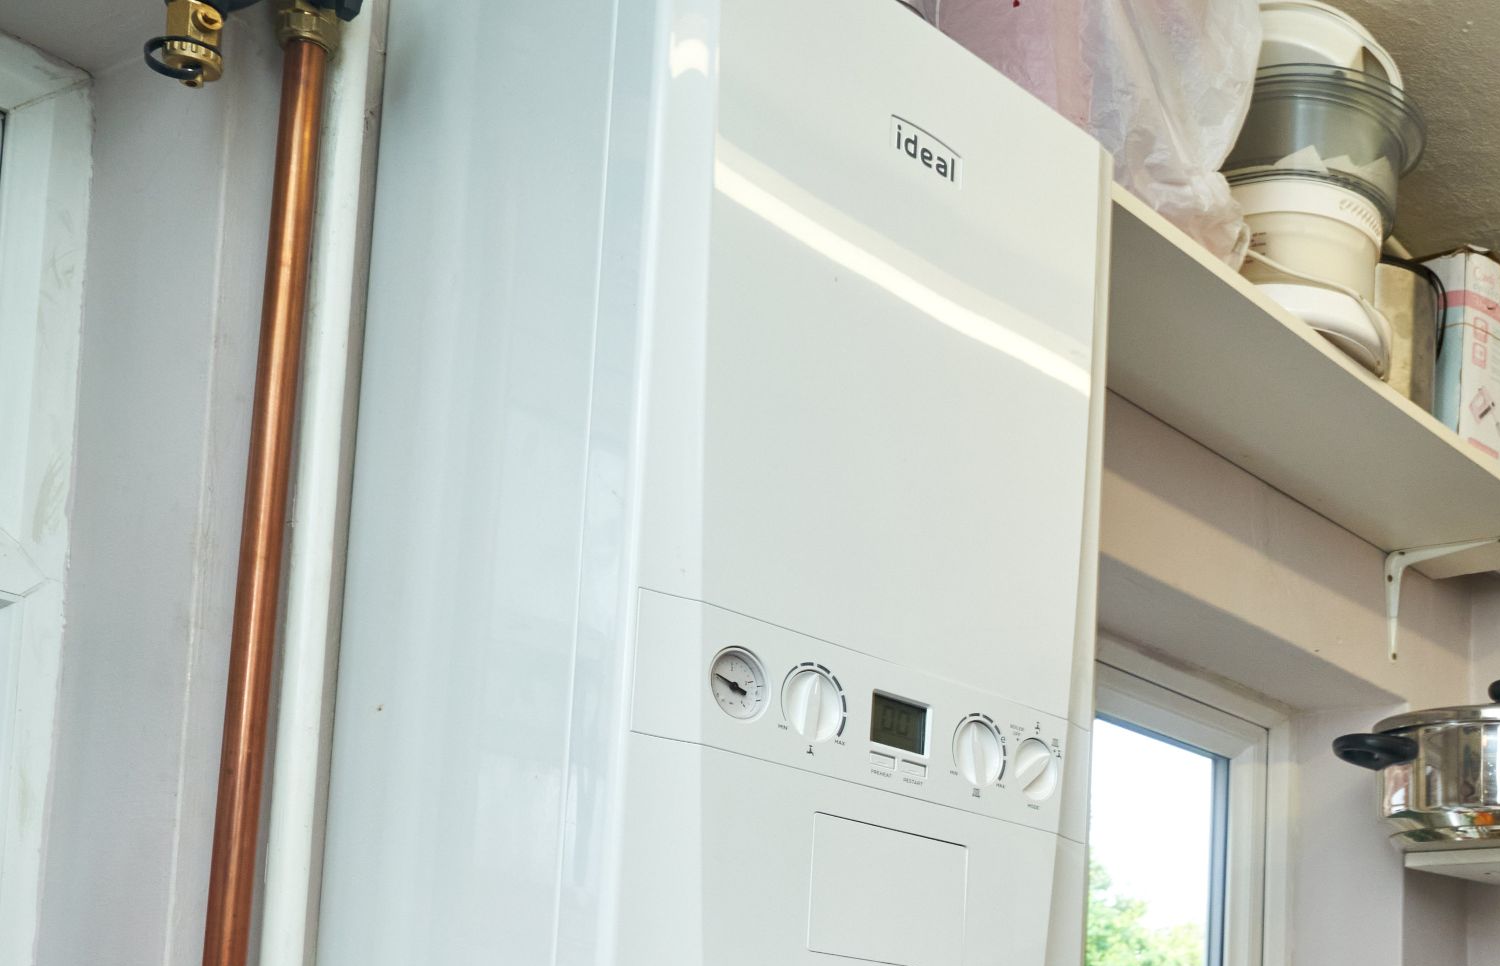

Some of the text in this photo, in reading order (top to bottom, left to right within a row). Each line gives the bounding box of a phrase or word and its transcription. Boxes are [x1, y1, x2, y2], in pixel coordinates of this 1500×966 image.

[895, 123, 955, 183] ideal
[870, 768, 893, 778] PREHEAT
[902, 777, 924, 786] RESTART
